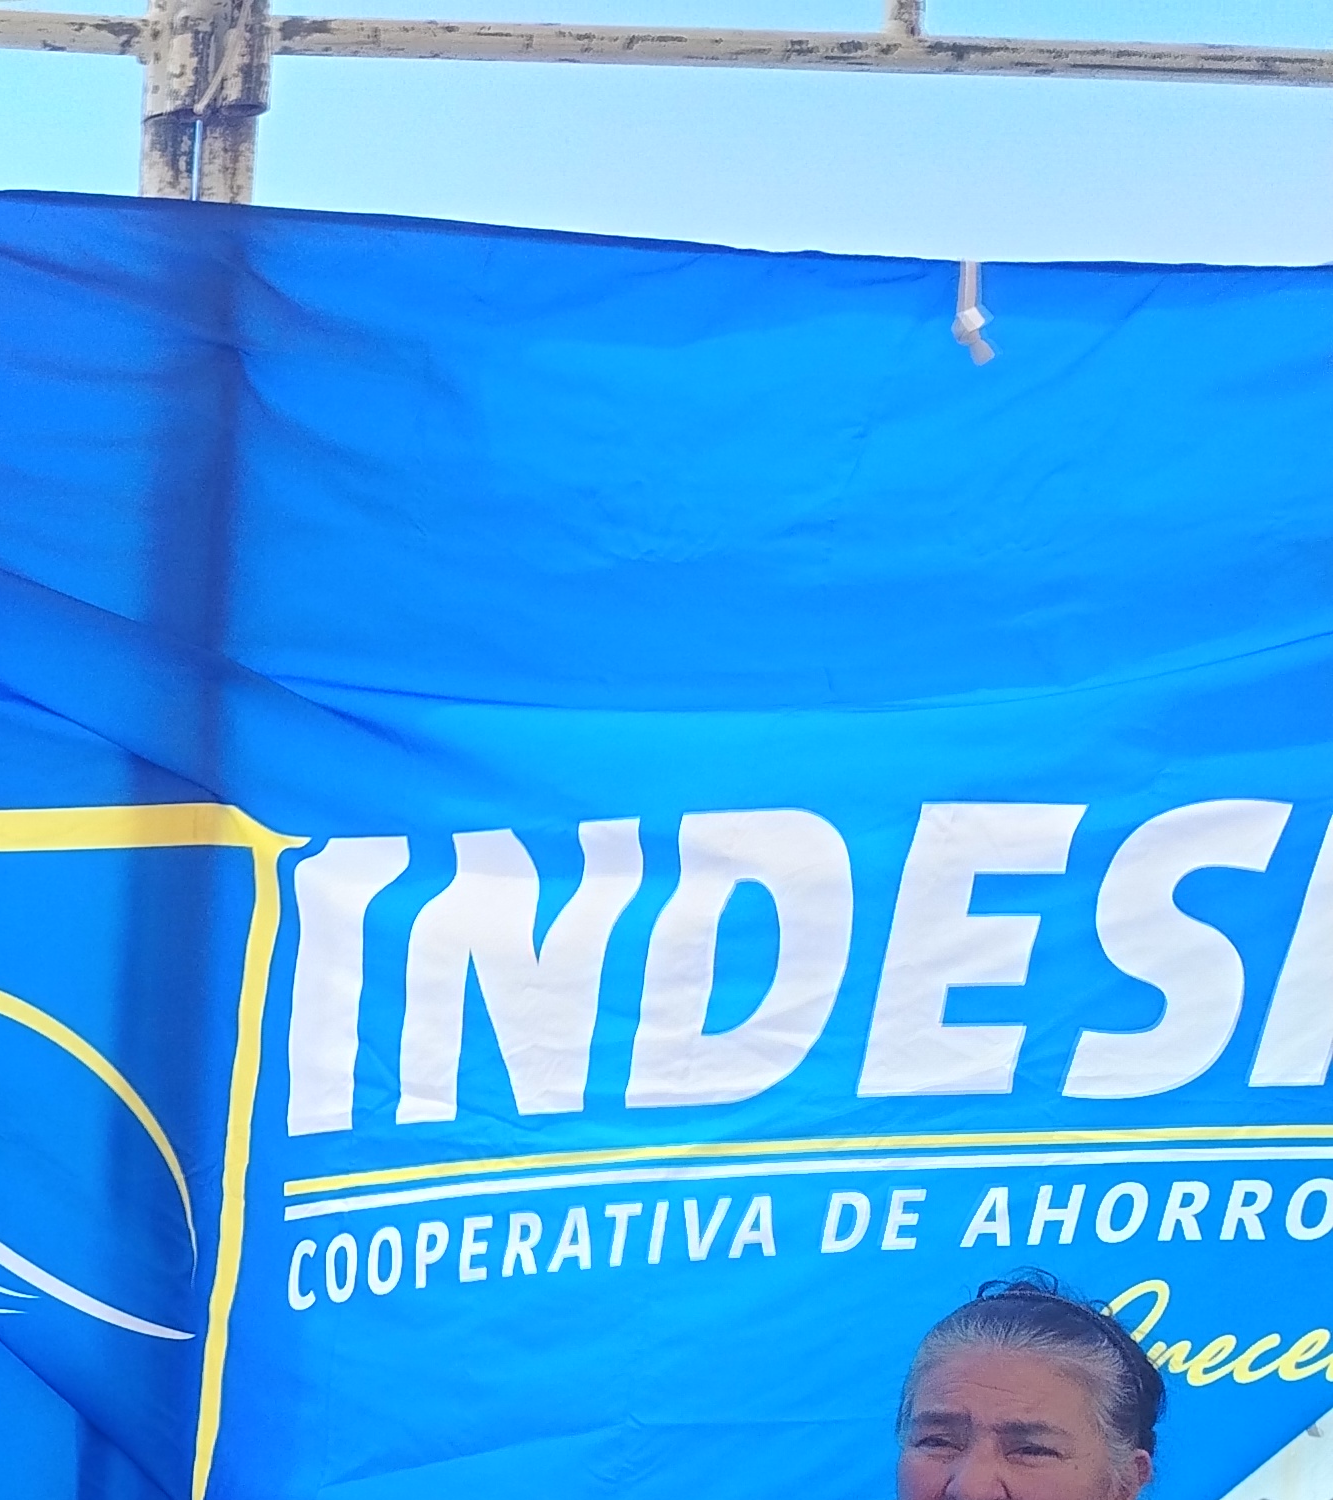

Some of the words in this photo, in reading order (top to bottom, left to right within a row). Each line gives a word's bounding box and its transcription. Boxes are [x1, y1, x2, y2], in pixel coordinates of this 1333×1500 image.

[287, 1194, 776, 1311] COOPERATIVA
[820, 1187, 927, 1254] DE
[959, 1178, 1333, 1248] AHORRO
